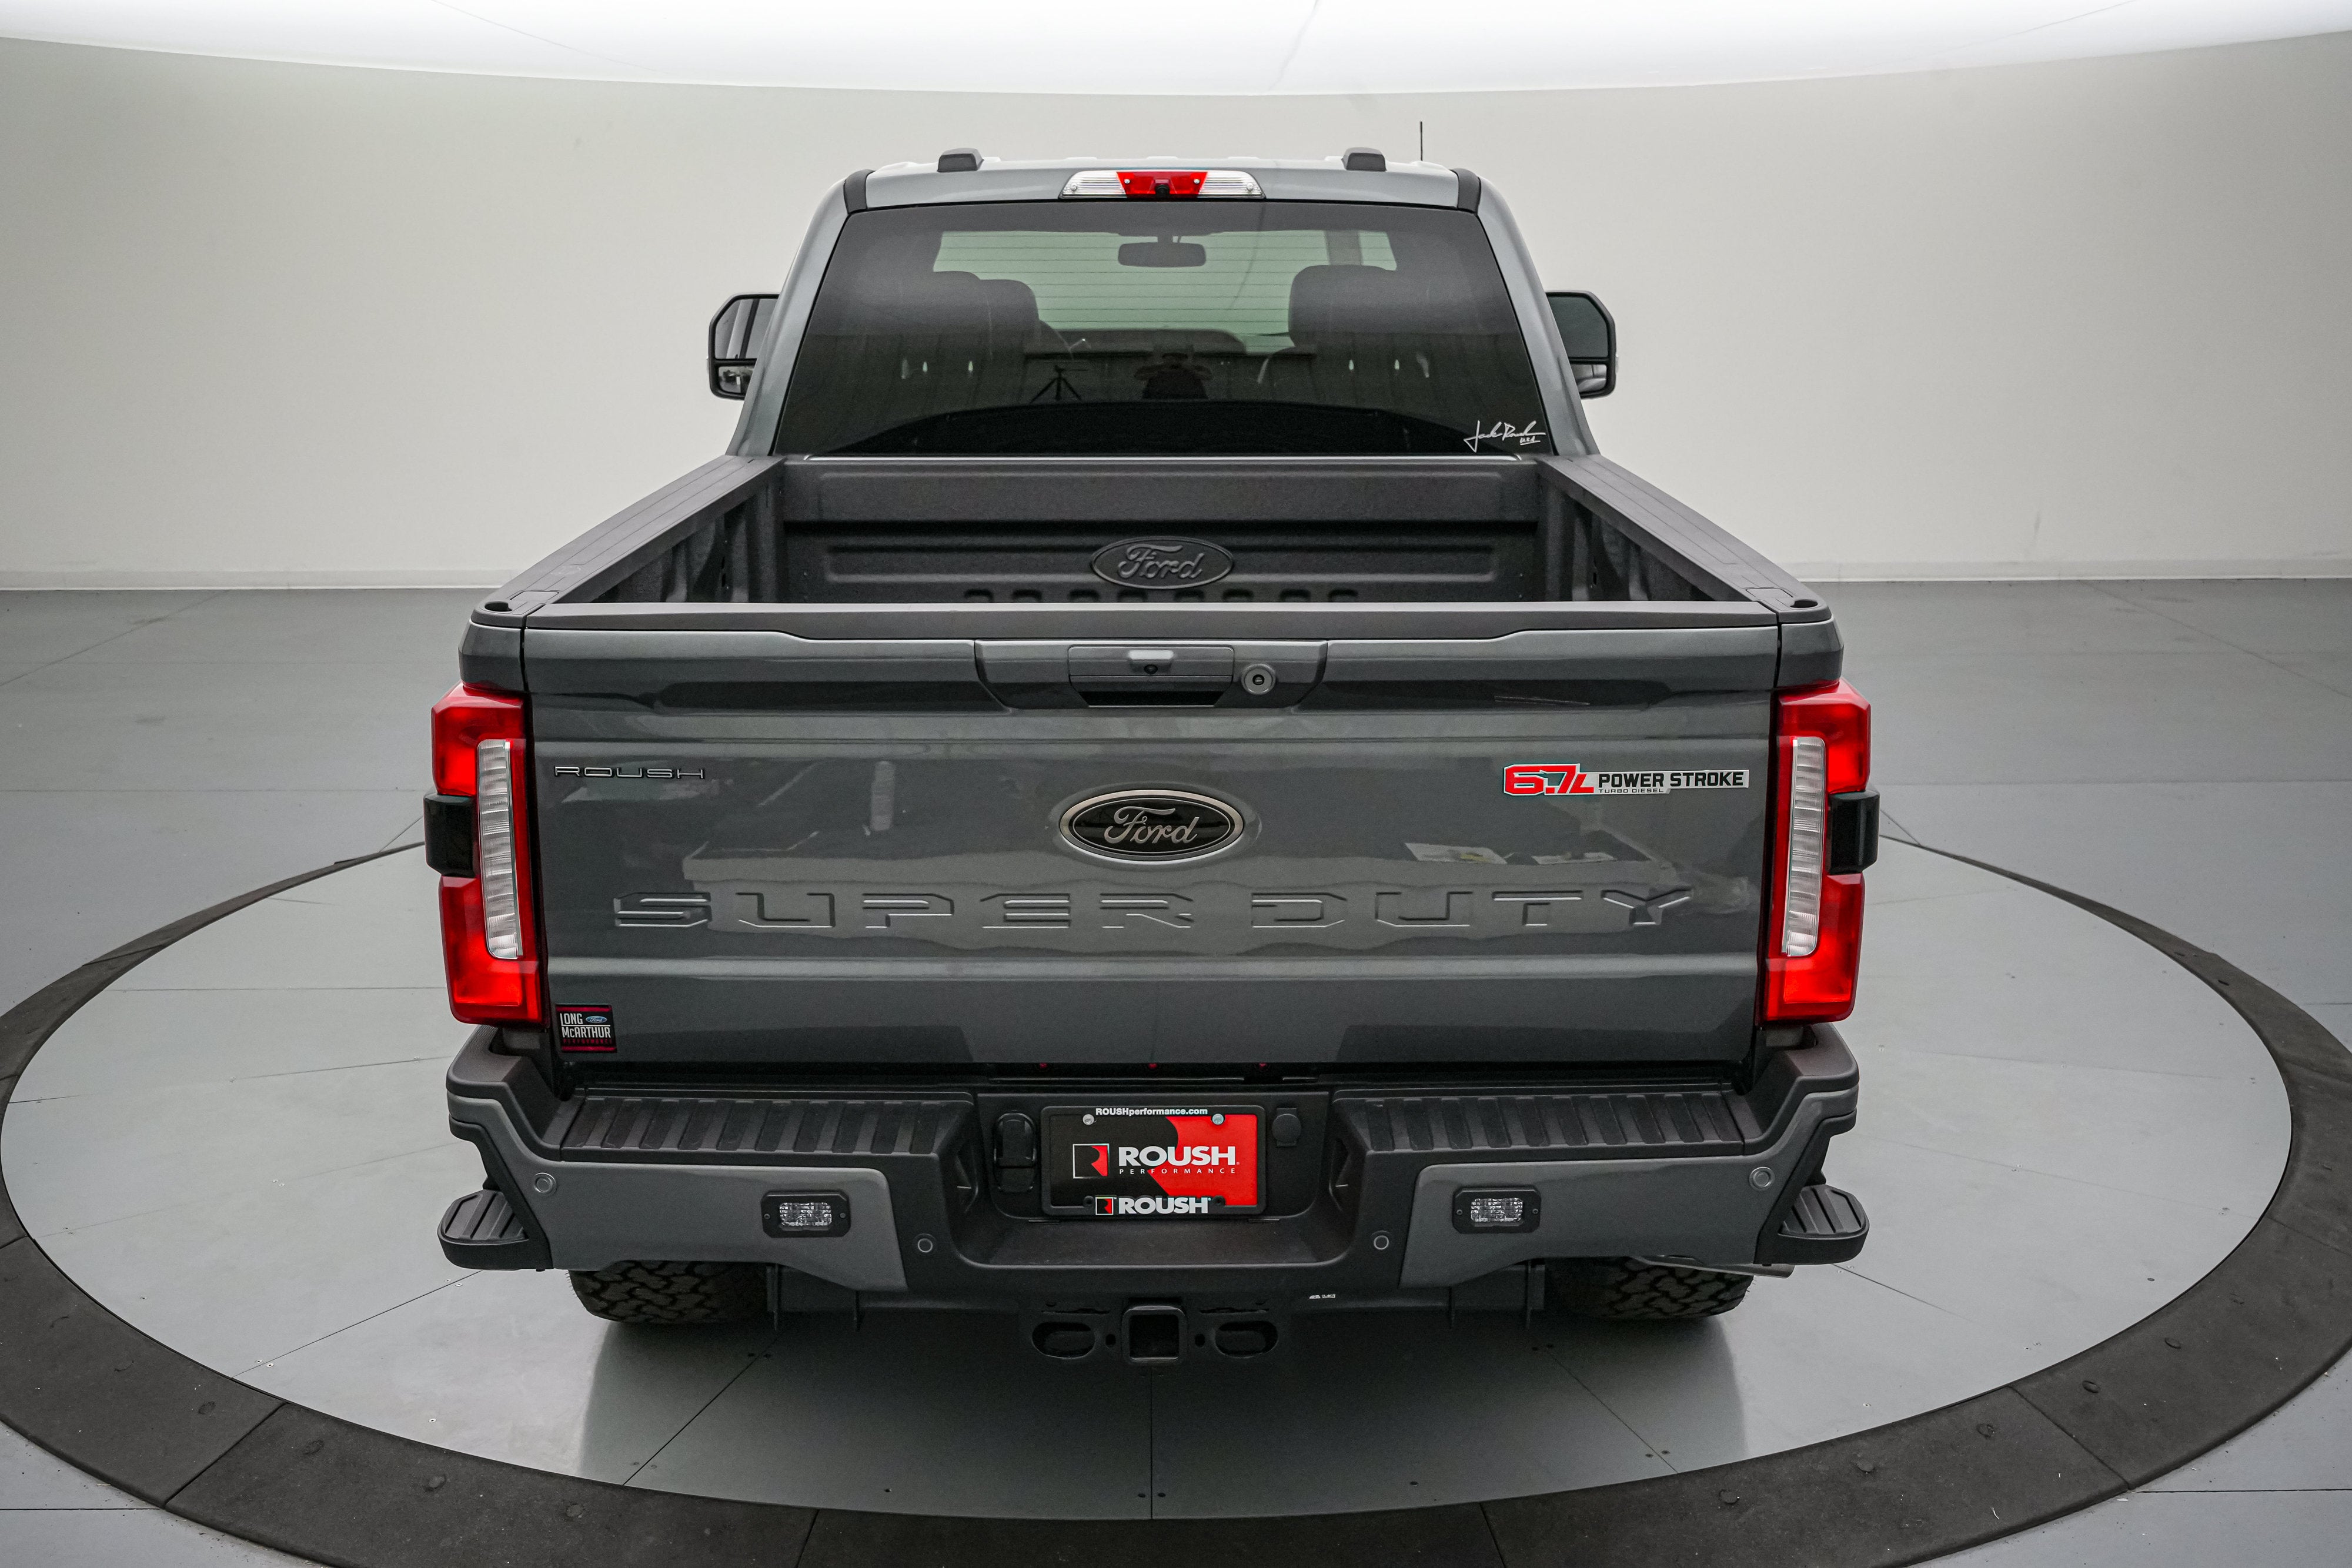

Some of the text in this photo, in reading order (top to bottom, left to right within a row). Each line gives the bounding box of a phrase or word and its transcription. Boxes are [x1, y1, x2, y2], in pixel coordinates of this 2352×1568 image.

[1118, 543, 1205, 579] Ford
[554, 766, 705, 779] ROUSH
[1505, 764, 1744, 794] 6.7L POWER STROKE
[1104, 806, 1200, 844] Ford
[613, 889, 1692, 928] SUPER DUTY
[560, 1013, 583, 1027] LONG
[562, 1027, 611, 1038] McARTHUR
[1095, 1108, 1208, 1116] ROUSHperformance.com
[1118, 1146, 1235, 1166] ROUSH
[1118, 1197, 1208, 1214] ROUSH
